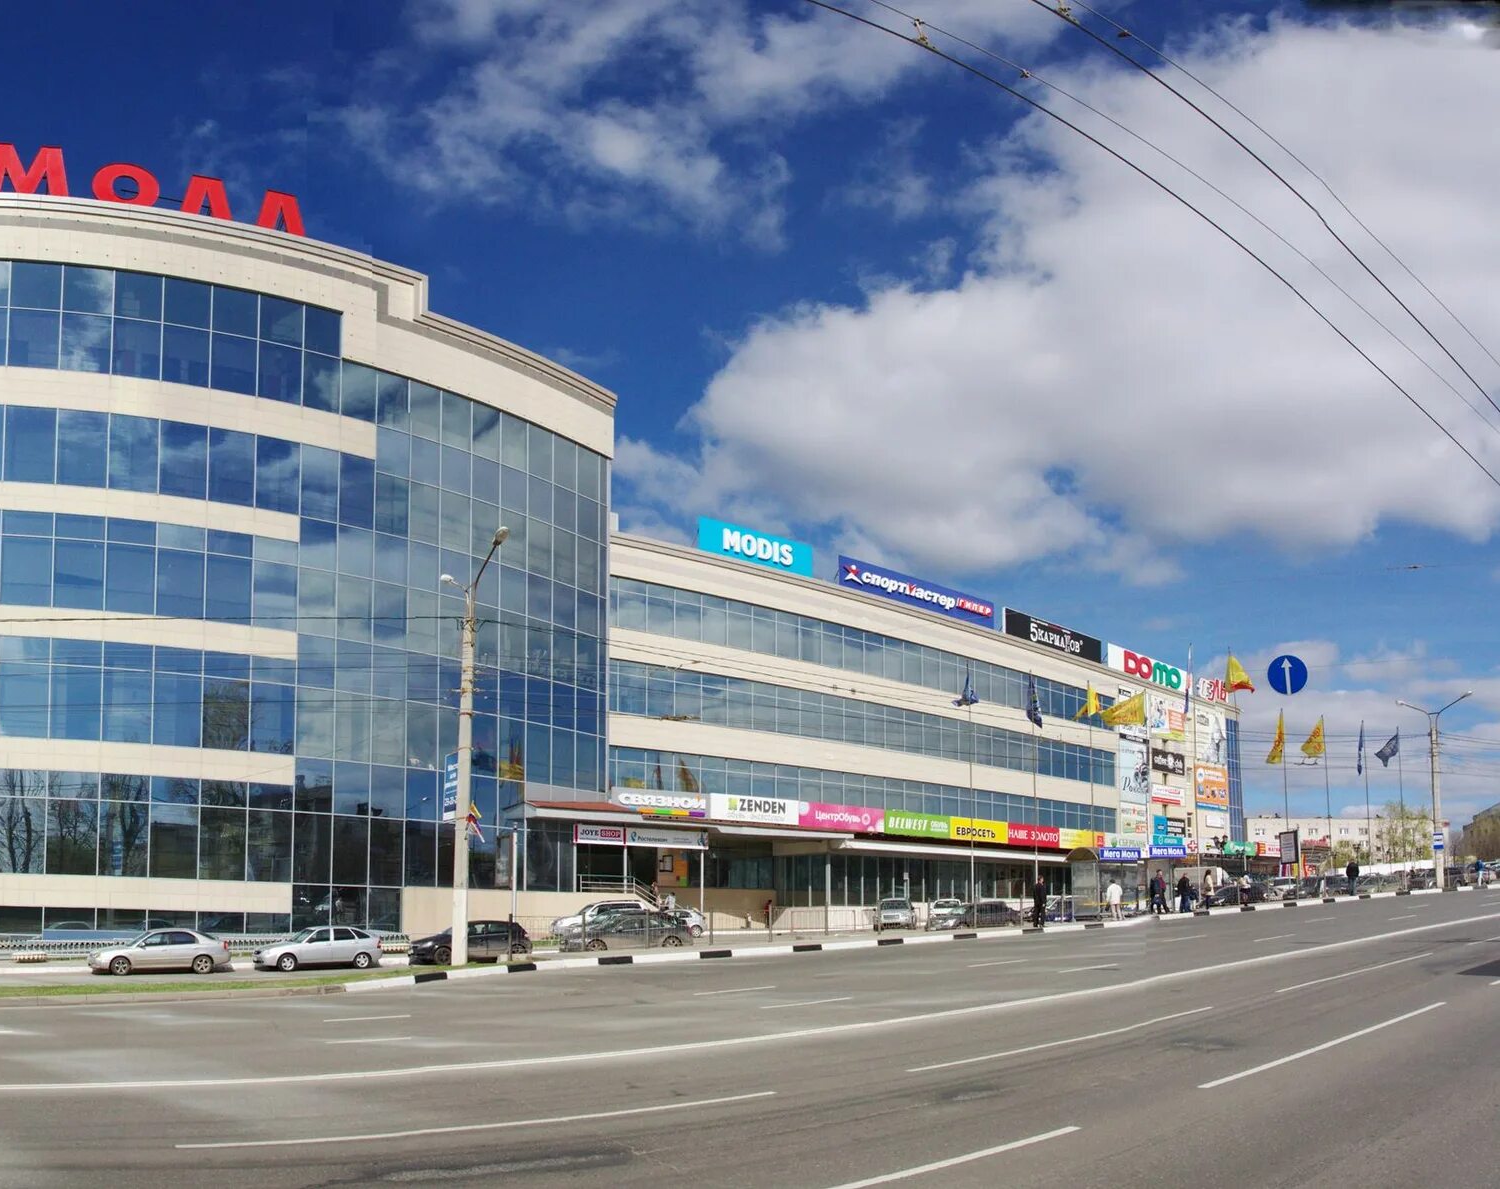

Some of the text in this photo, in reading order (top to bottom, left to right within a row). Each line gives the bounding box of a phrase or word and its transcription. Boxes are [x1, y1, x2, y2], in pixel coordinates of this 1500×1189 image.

[722, 527, 794, 566] MODIS
[739, 798, 786, 814] ZENDEN
[815, 811, 861, 824] ЦентрОбувь
[888, 816, 928, 831] BELWEST
[580, 828, 621, 838] JOYE SHOP
[956, 826, 996, 839] ЕВРОСЕТЬ
[1008, 829, 1028, 840] НАШЕ
[1030, 831, 1059, 843] ЗОЛОТО
